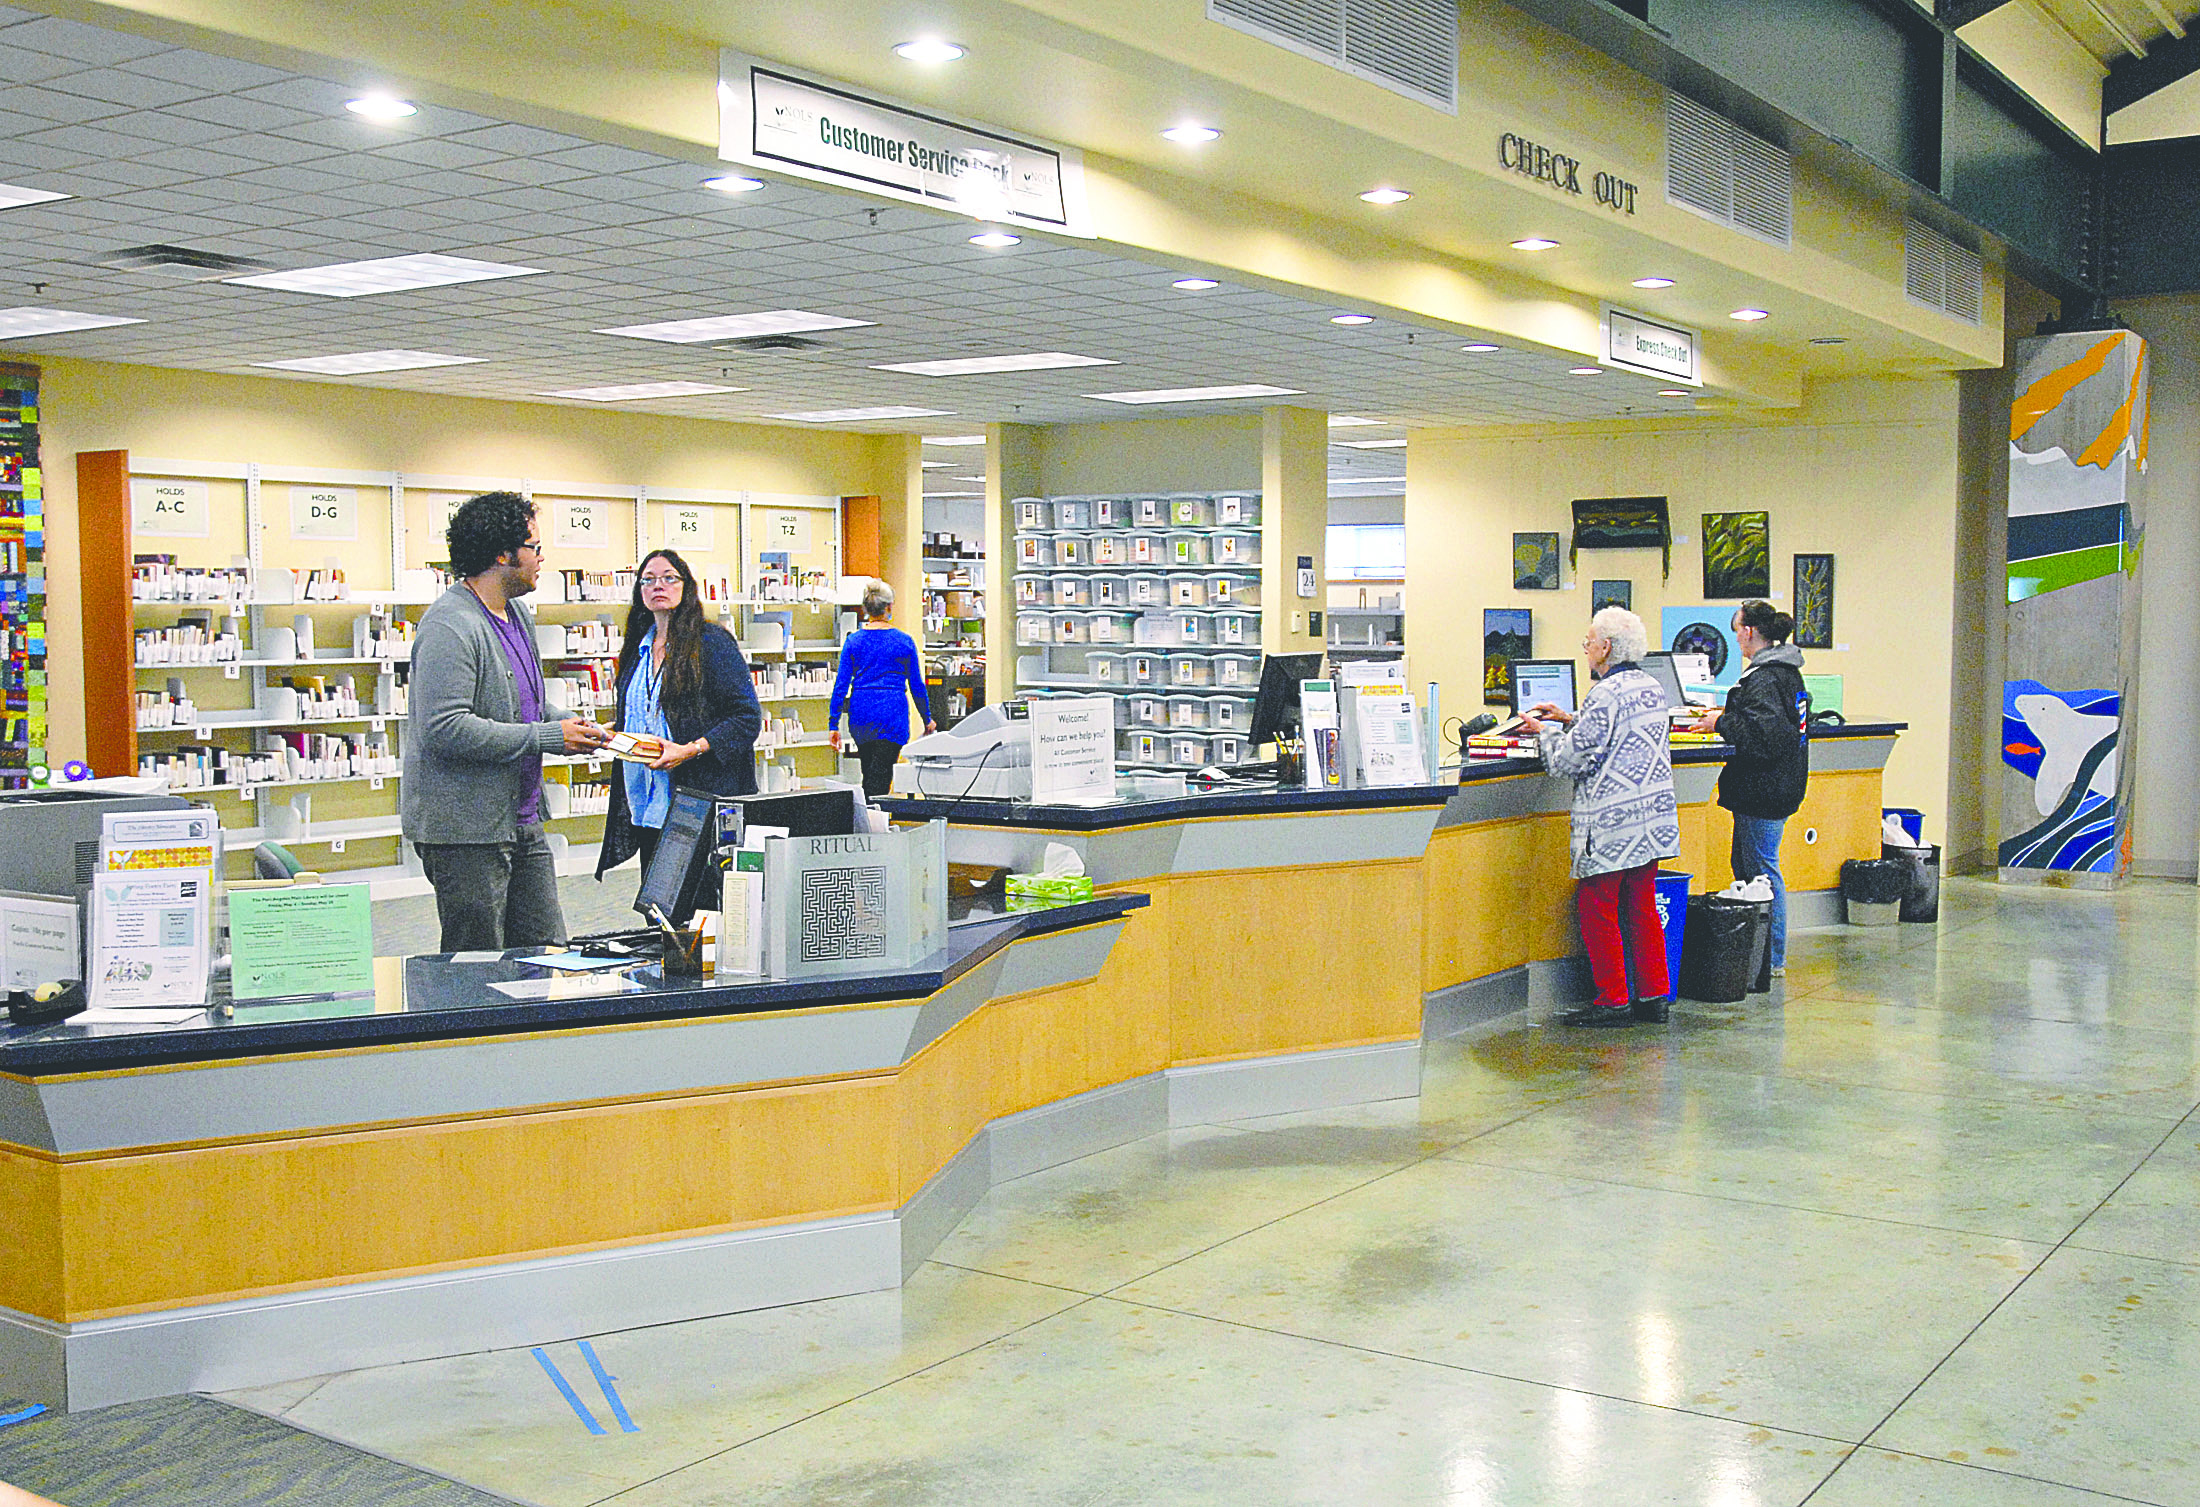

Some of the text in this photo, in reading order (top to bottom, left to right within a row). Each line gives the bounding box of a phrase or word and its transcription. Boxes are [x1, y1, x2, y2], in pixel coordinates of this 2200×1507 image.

[820, 117, 905, 163] Customer
[908, 141, 969, 178] Service
[1500, 132, 1638, 215] CHECK OUT
[1636, 335, 1687, 363] Express Check Out
[156, 487, 185, 496] HOLDS
[311, 494, 337, 502] HOLDS
[155, 500, 185, 513] A-C
[311, 506, 338, 519] D-G
[571, 517, 592, 530] L-Q
[681, 521, 698, 532] R-S
[781, 525, 796, 536] T-Z
[1302, 572, 1315, 587] 24
[1058, 713, 1089, 724] Welcome!
[1040, 734, 1055, 744] How
[1069, 733, 1078, 741] we
[1079, 731, 1092, 743] help
[1093, 729, 1106, 741] you?
[335, 841, 341, 849] G
[811, 836, 878, 854] RITUAL
